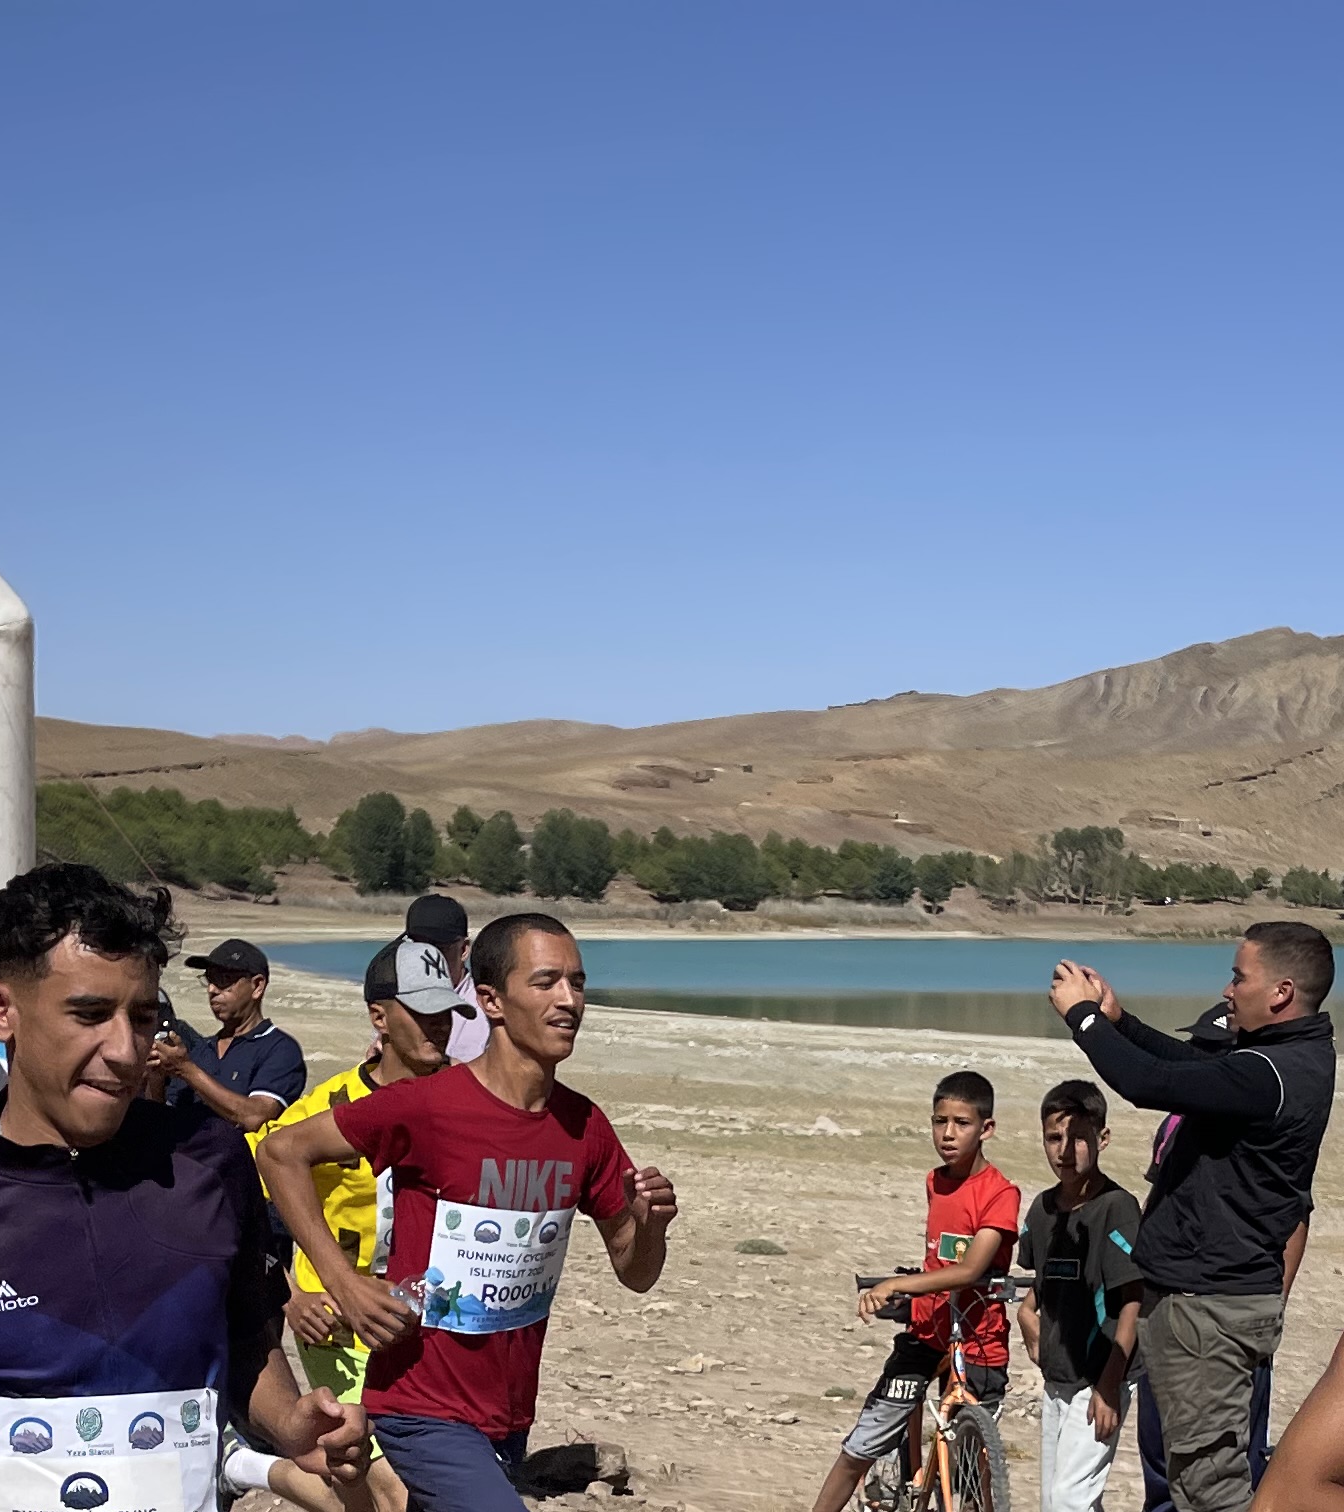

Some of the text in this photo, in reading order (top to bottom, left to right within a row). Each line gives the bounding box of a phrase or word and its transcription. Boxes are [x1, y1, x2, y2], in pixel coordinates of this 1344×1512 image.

[478, 1158, 574, 1212] NIKE
[456, 1249, 515, 1265] RUNNING
[469, 1266, 527, 1280] ISLI-TISLIT
